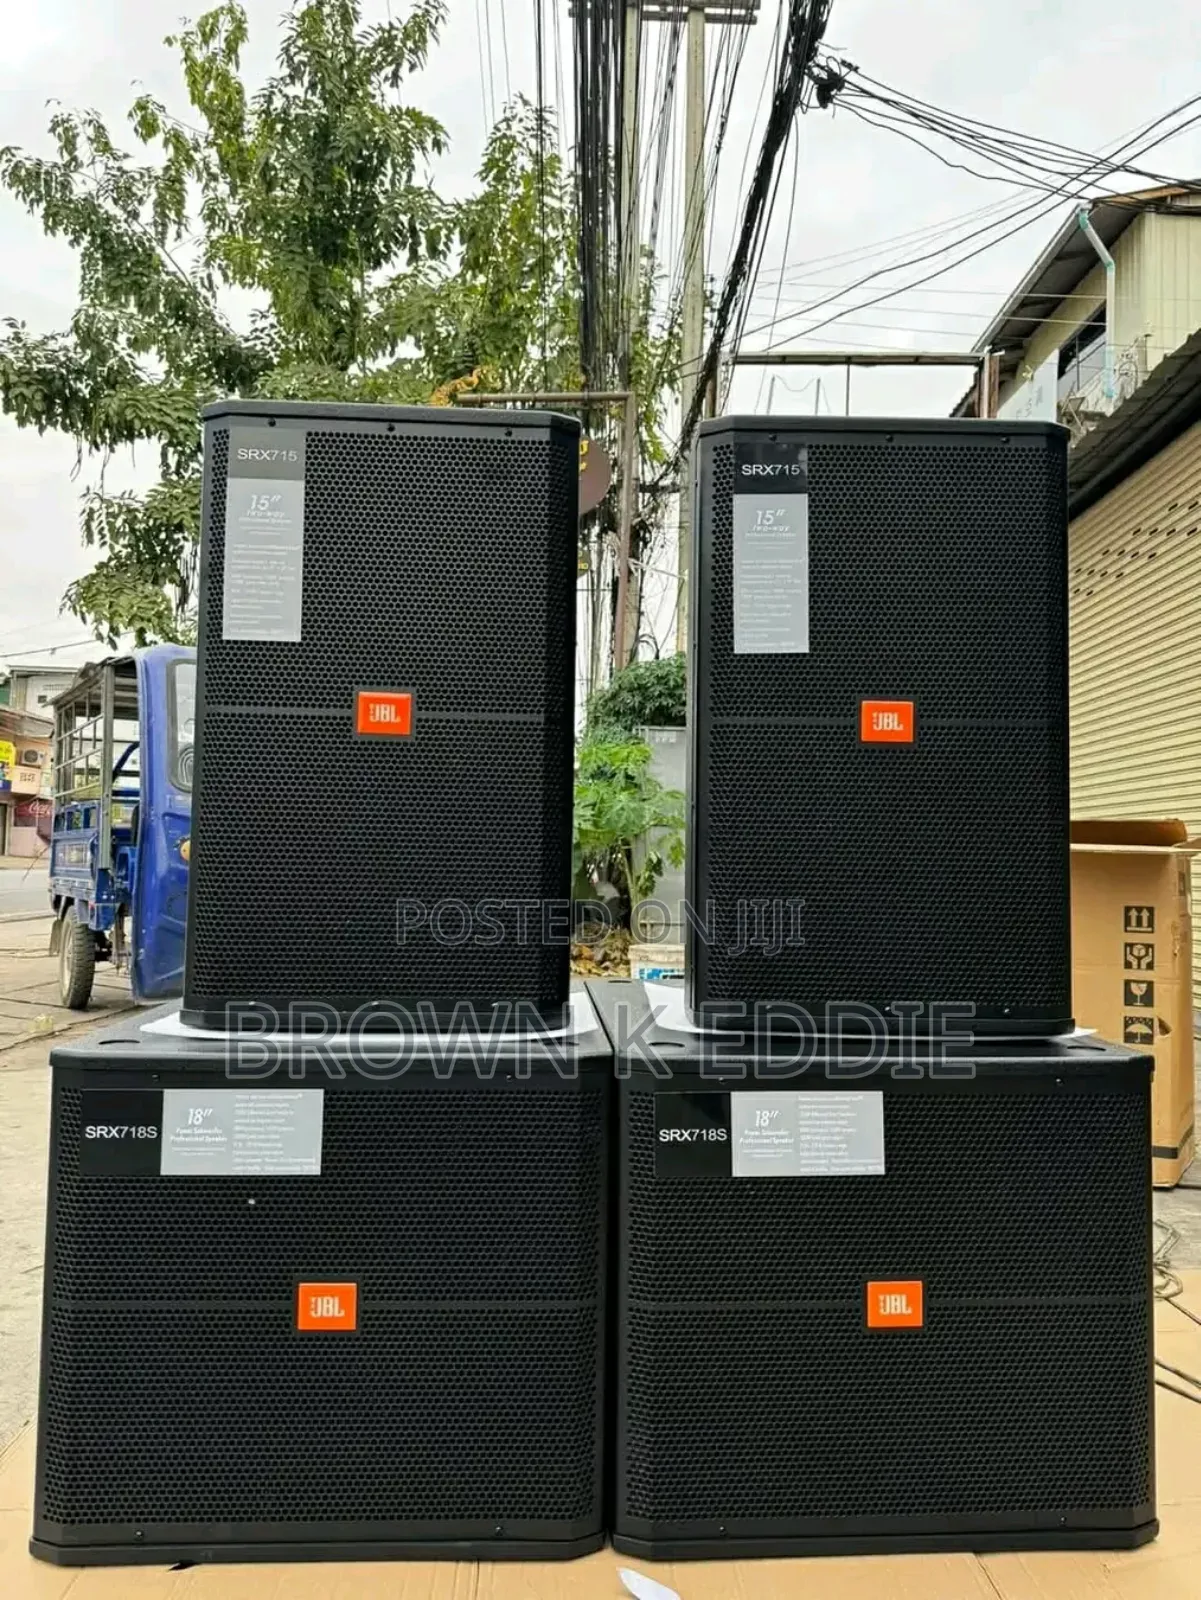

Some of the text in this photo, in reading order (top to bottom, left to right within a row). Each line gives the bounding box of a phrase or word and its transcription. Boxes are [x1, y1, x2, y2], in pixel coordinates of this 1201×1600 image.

[237, 448, 297, 462] SRX715
[741, 464, 800, 476] SRX715
[369, 703, 402, 723] JBL
[871, 711, 904, 731] JBL
[85, 1125, 158, 1139] SRX718S
[659, 1128, 727, 1142] SRX718S
[309, 1295, 346, 1318] JBL
[877, 1294, 913, 1316] JBL
